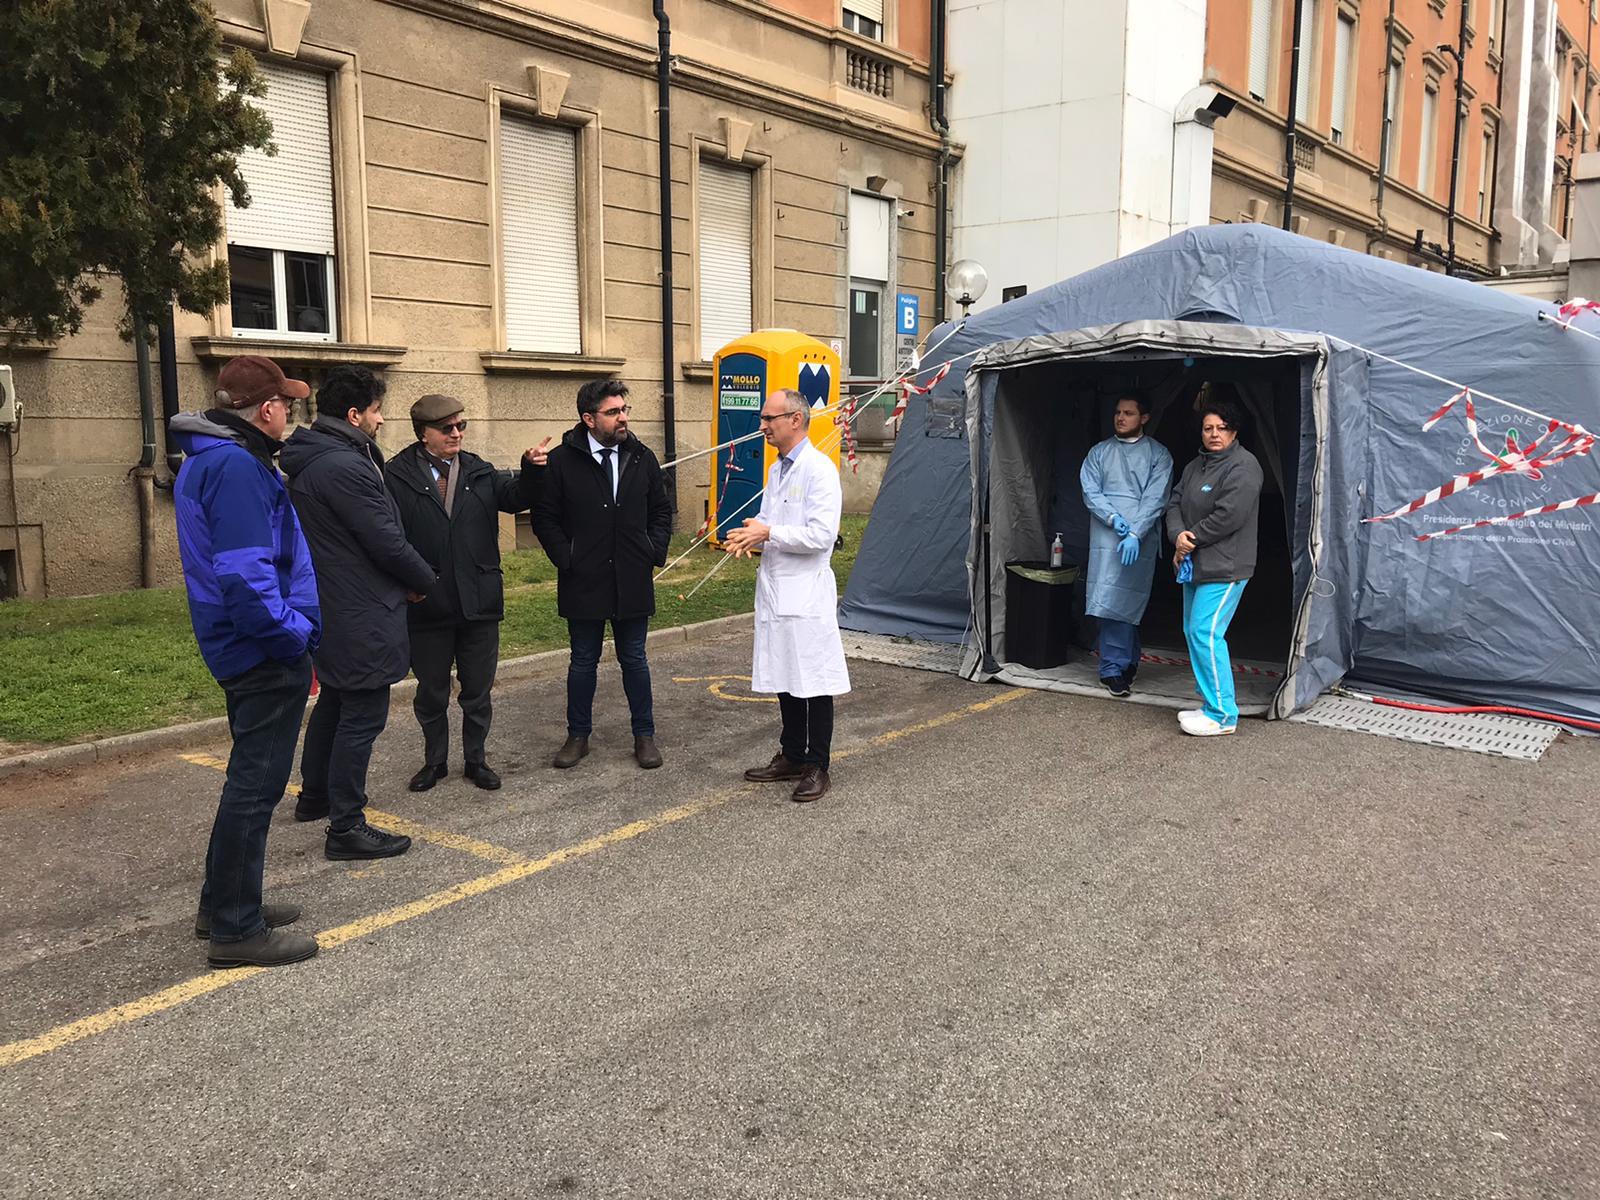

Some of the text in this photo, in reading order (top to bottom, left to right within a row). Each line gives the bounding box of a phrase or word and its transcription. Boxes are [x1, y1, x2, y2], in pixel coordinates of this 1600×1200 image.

[904, 306, 915, 329] B
[733, 376, 760, 384] MOLLO
[1456, 414, 1536, 466] PROEZIONE
[1466, 482, 1552, 508] AZIONALE
[1423, 514, 1472, 524] Presidenza
[1555, 520, 1592, 531] Ministri
